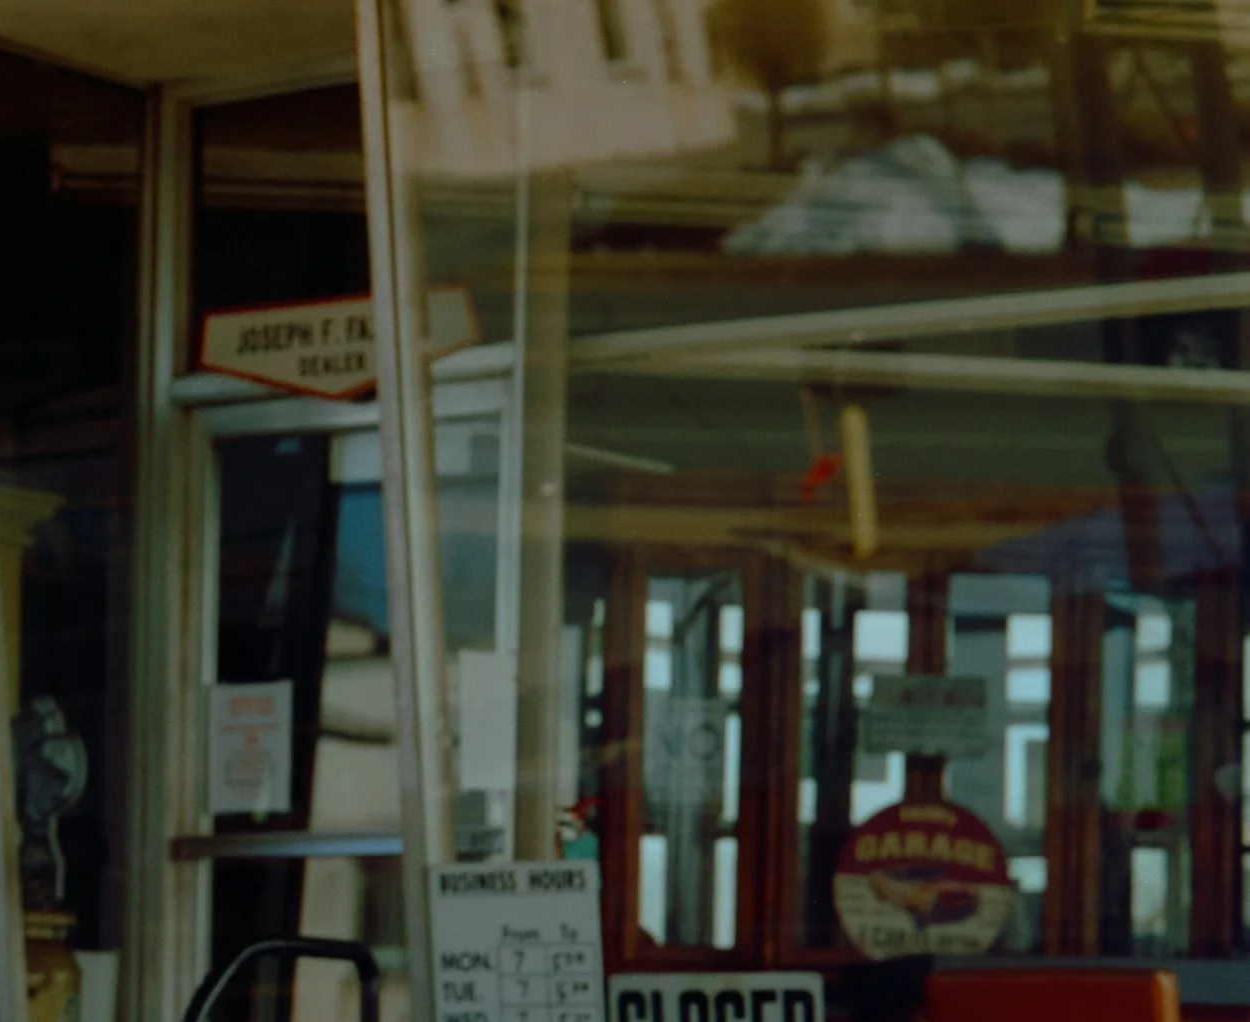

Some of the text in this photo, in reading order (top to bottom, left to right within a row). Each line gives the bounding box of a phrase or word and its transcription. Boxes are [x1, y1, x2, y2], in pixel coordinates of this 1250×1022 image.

[236, 319, 314, 357] JOSEPH
[297, 349, 368, 378] DEALER
[853, 830, 994, 875] GARAGE
[439, 869, 587, 895] BUSINESS HOURS
